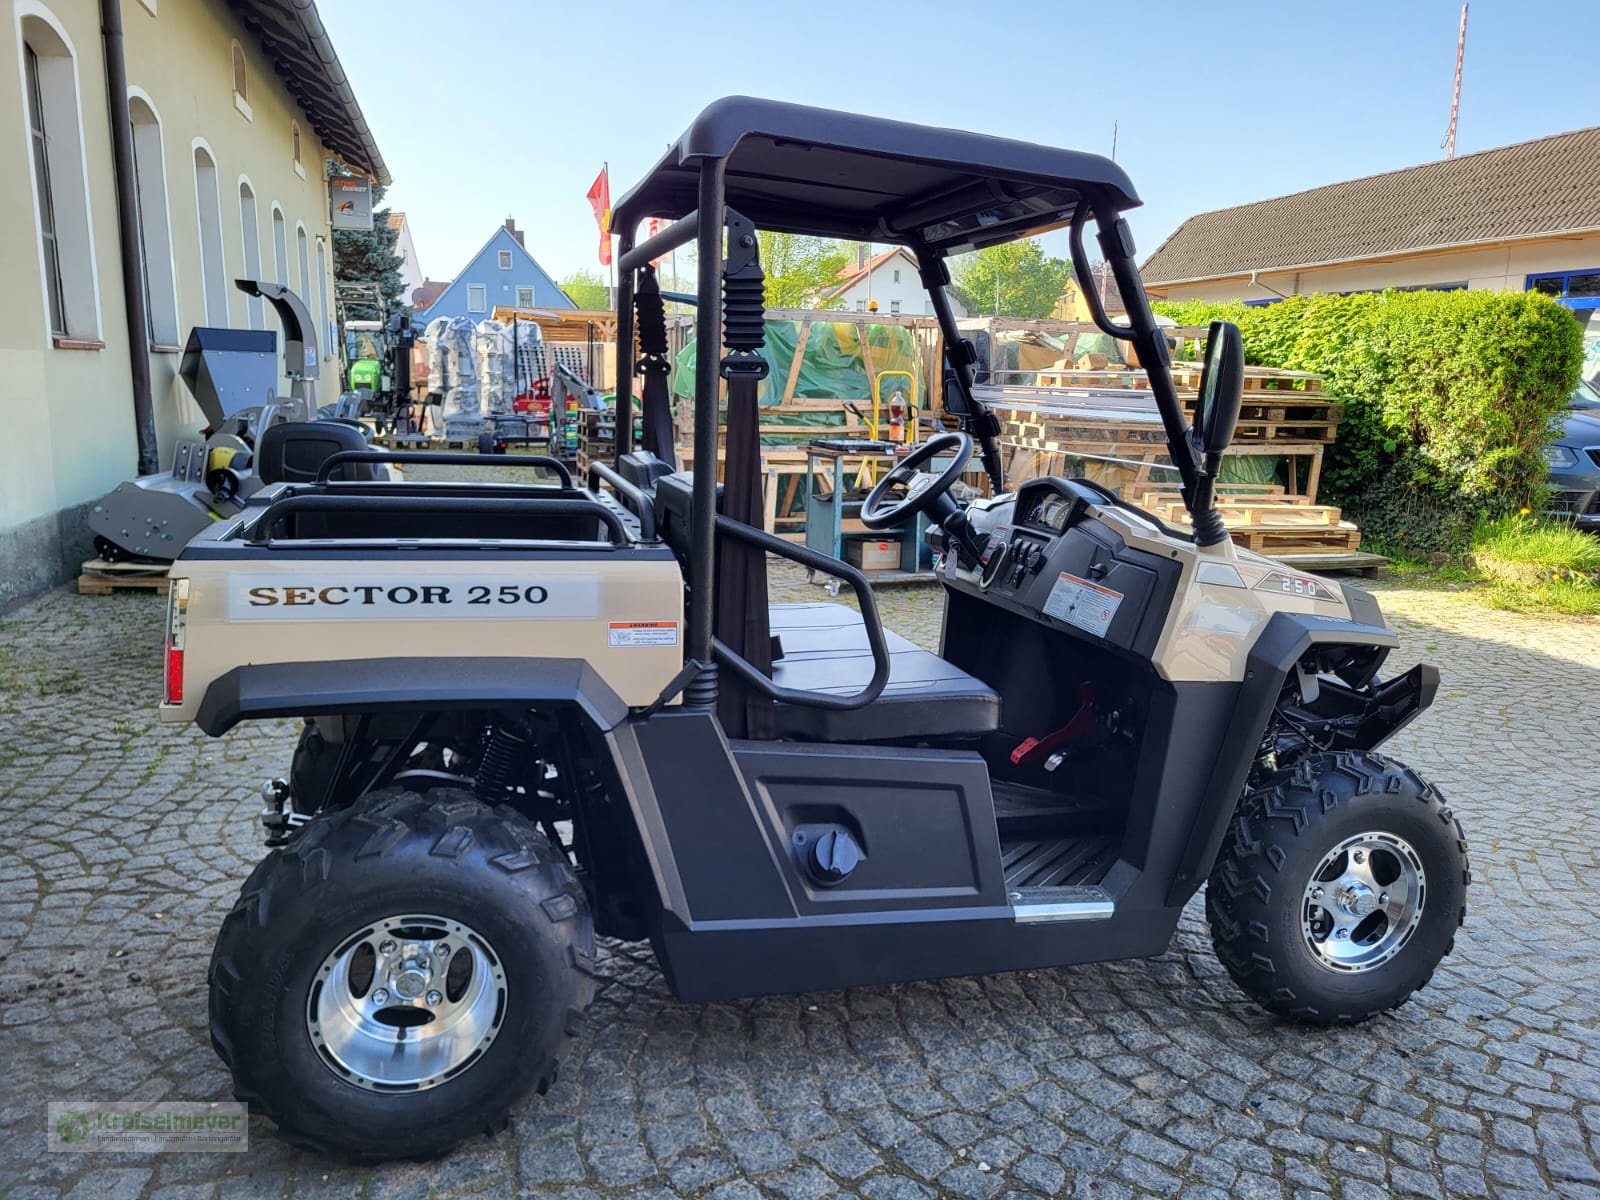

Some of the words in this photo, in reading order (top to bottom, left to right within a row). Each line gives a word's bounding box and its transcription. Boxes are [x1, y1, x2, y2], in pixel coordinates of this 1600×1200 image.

[248, 586, 453, 606] SECTOR
[467, 585, 548, 605] 250
[1282, 577, 1316, 596] 250
